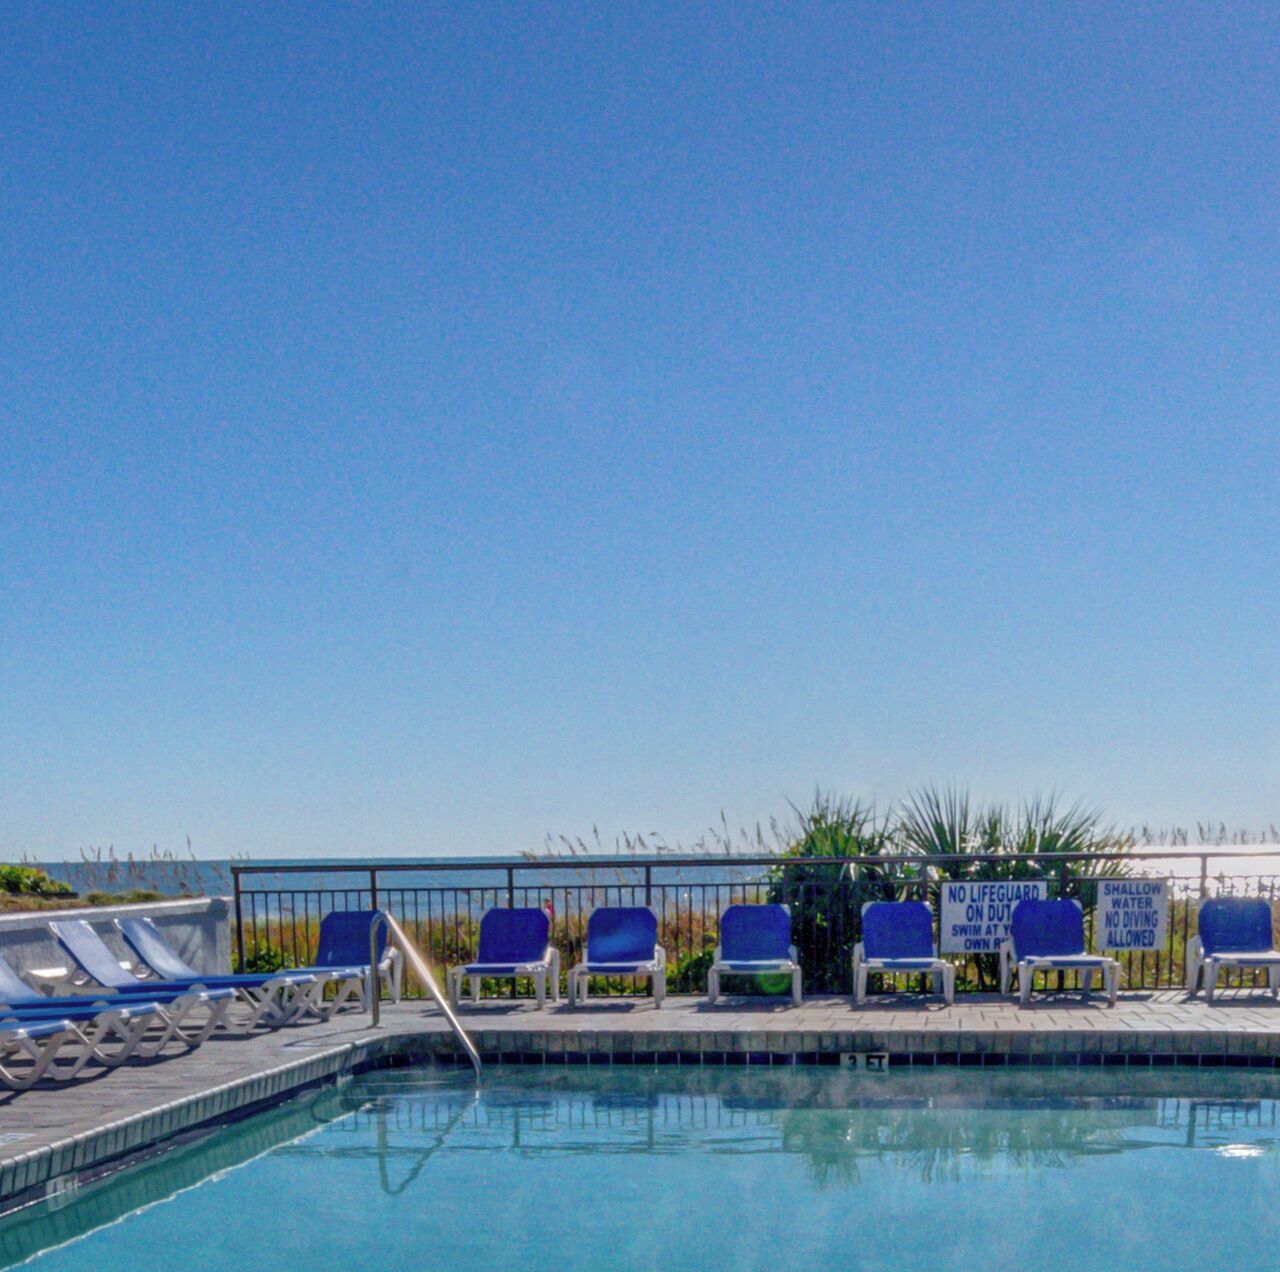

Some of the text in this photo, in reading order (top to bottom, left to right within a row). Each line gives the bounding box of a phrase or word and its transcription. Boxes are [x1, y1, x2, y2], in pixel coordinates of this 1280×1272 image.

[949, 885, 1040, 903] NO LIFEGUARD
[1104, 883, 1162, 895] SHALLOW
[1111, 897, 1153, 909] WATER
[966, 904, 1011, 922] ON DUT
[1105, 910, 1159, 928] NO DIVING
[951, 924, 982, 936] SWIM
[985, 924, 1000, 936] AT
[964, 938, 991, 950] OWN
[1106, 929, 1156, 947] ALLOWED
